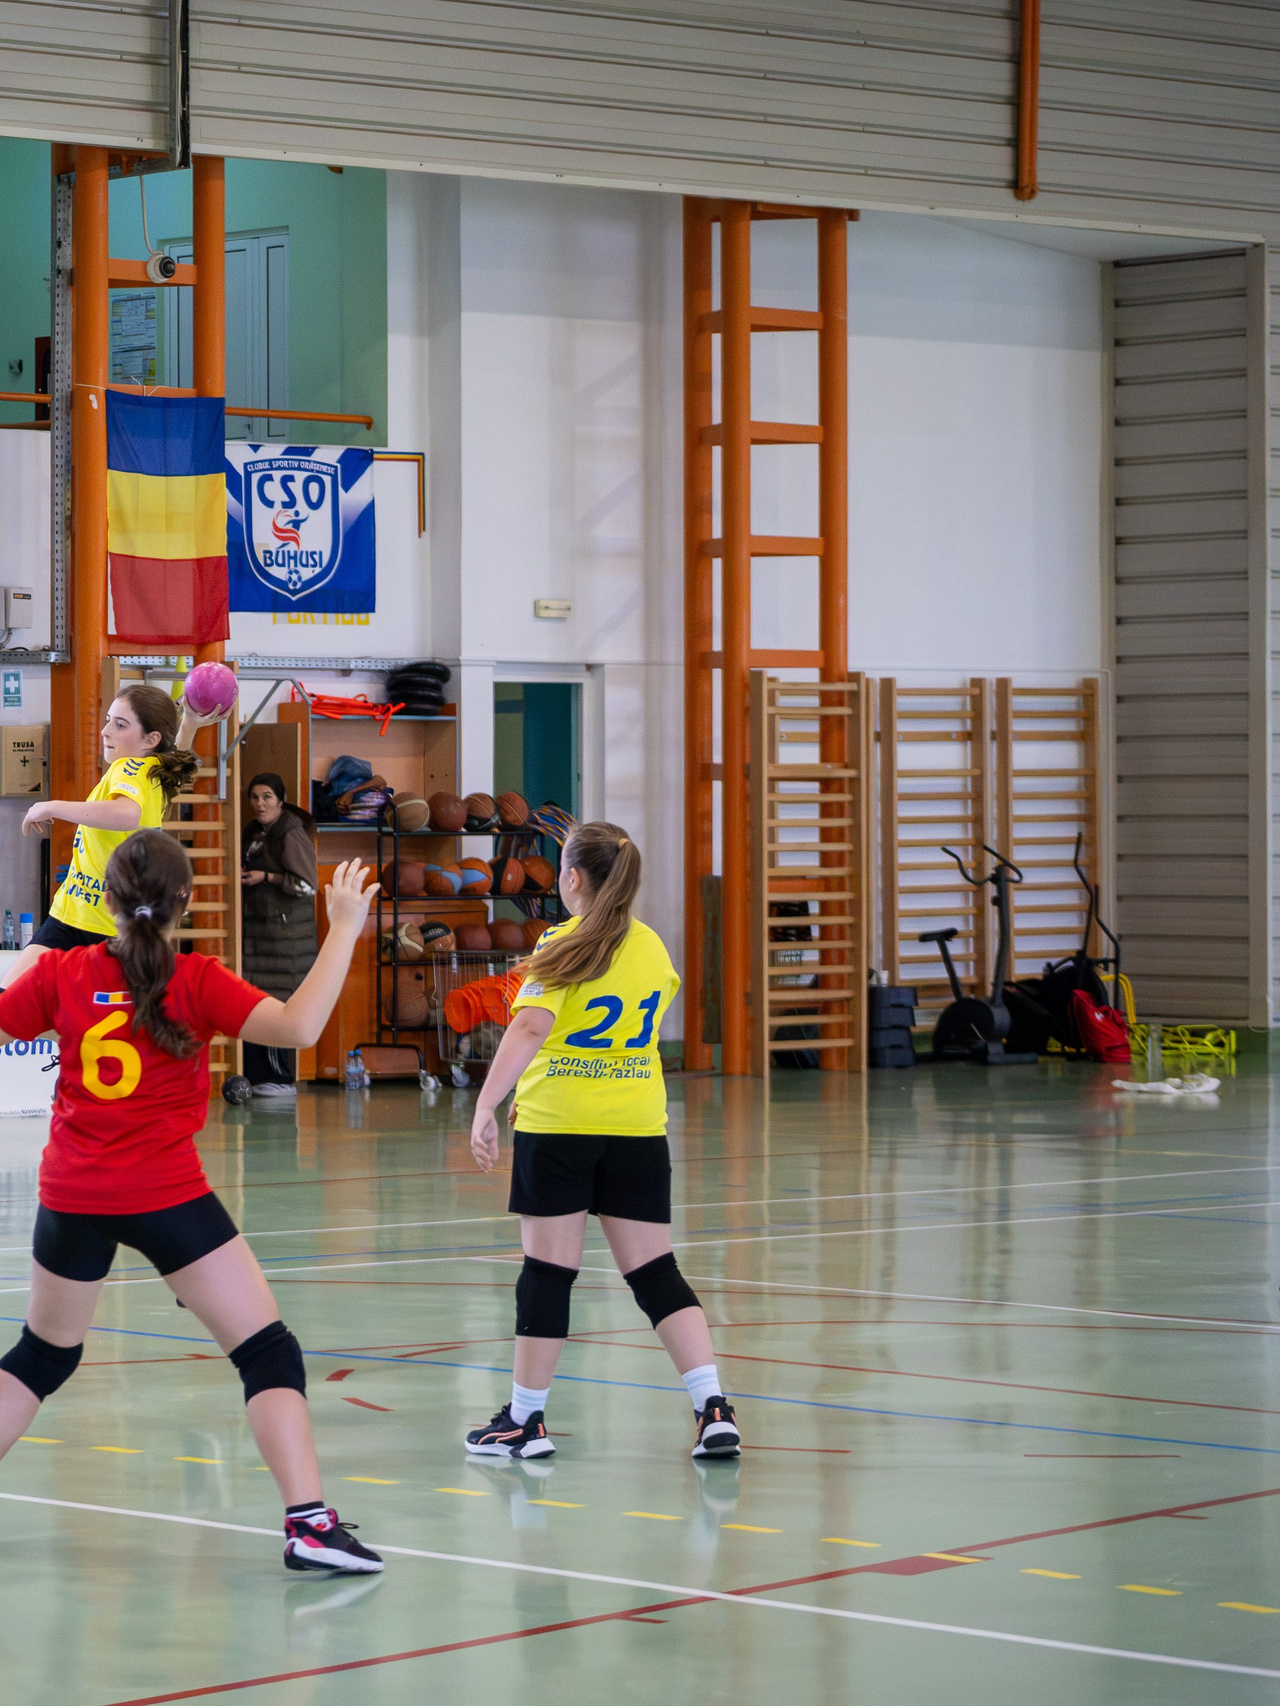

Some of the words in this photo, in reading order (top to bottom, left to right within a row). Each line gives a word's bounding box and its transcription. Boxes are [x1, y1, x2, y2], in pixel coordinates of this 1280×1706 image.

[272, 460, 299, 469] SPORTIV
[257, 473, 326, 511] CSO
[564, 991, 661, 1048] 21
[80, 1010, 142, 1099] 6
